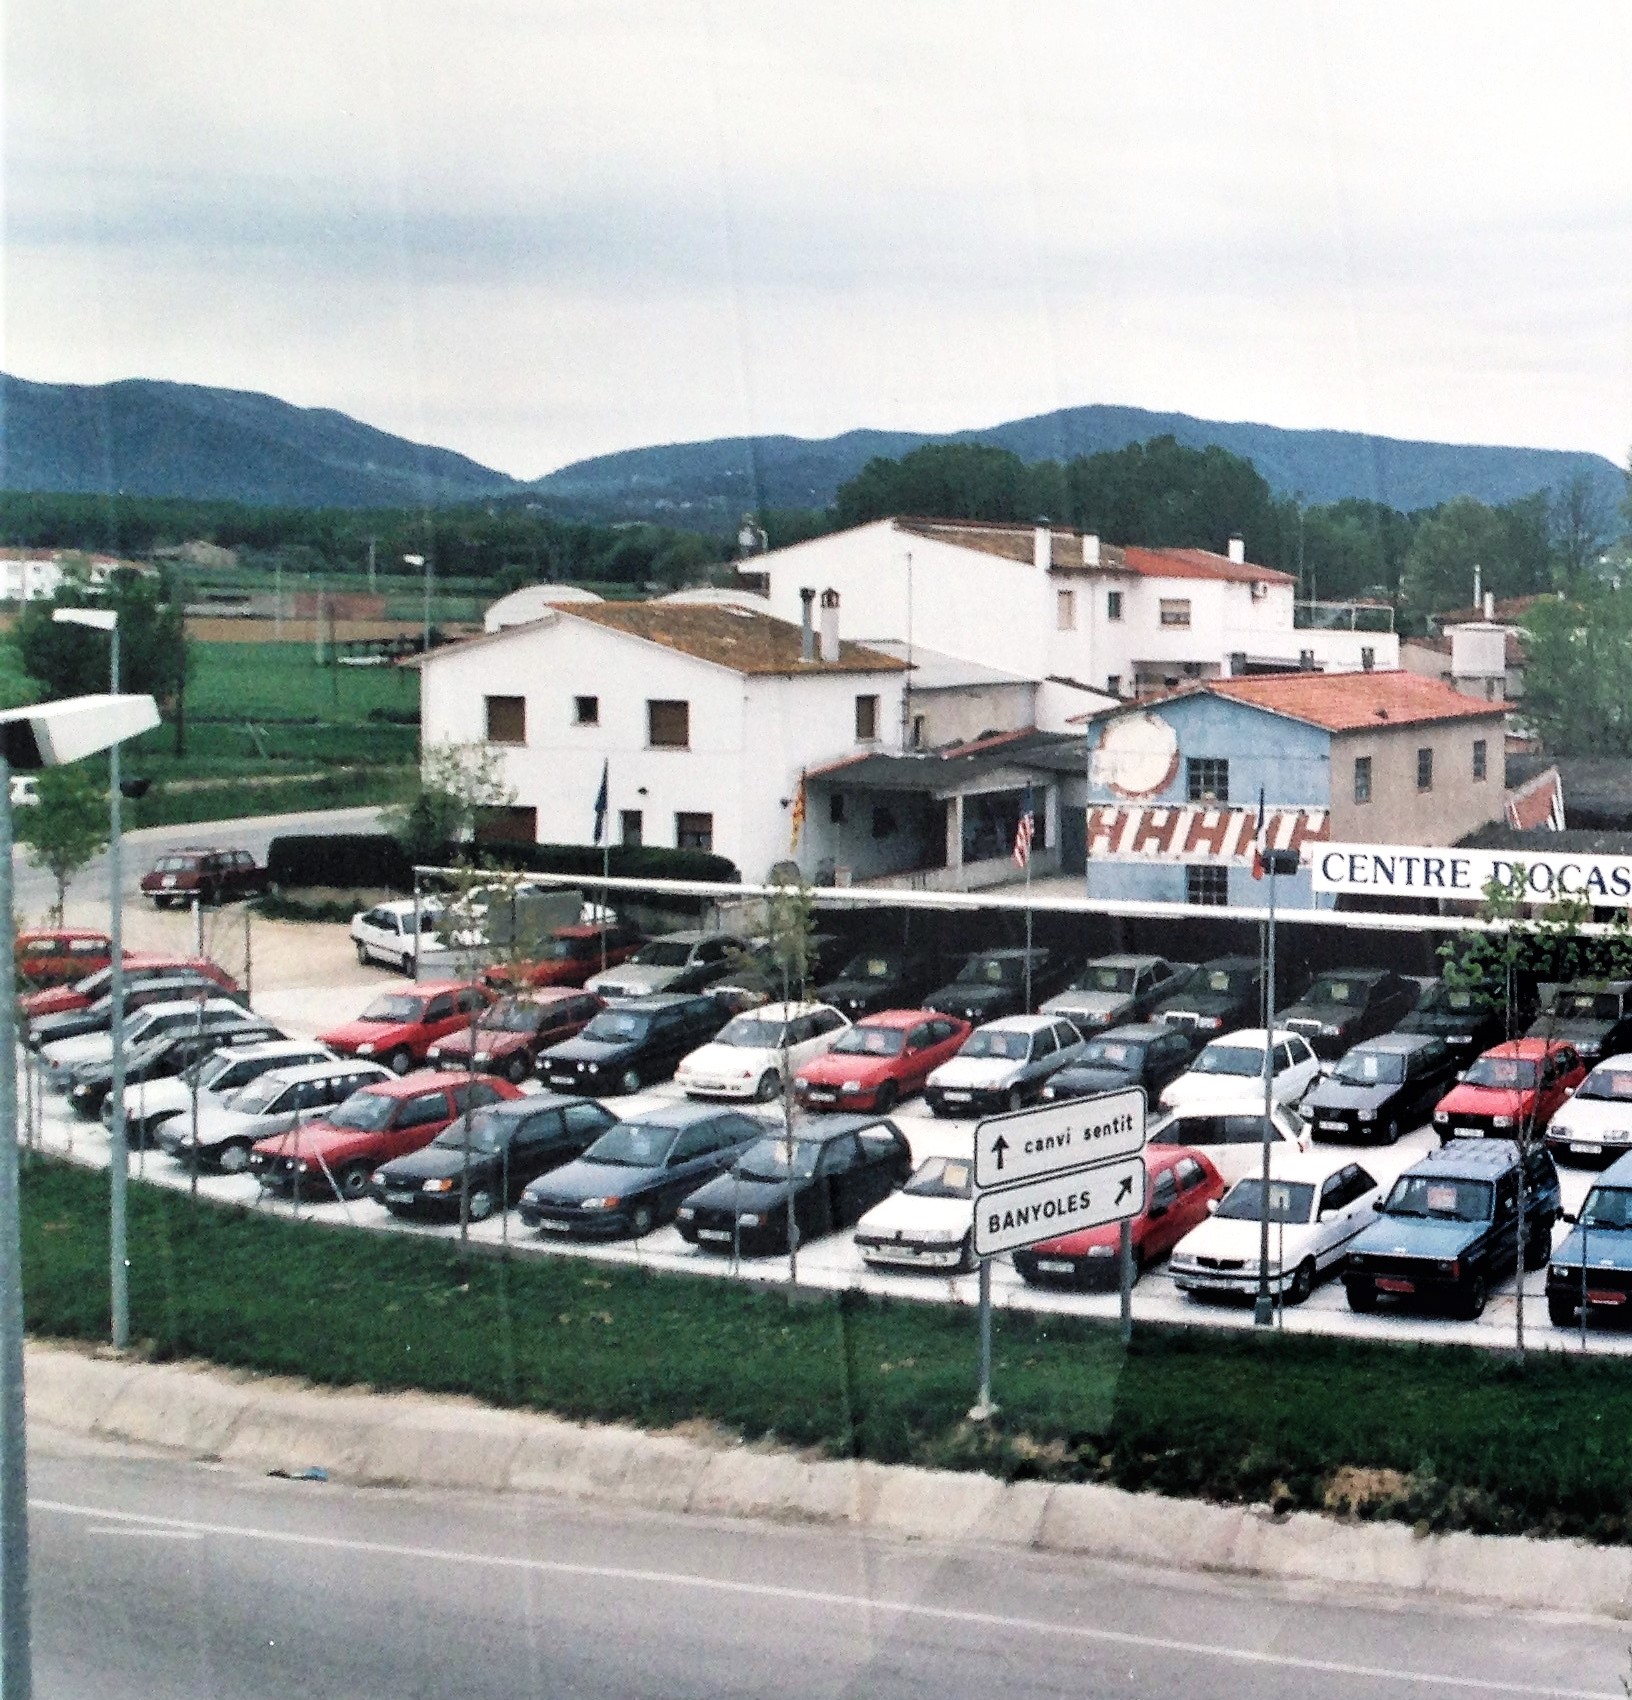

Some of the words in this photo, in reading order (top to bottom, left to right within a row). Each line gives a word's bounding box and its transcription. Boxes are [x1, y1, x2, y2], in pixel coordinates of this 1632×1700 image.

[1321, 852, 1470, 889] CENTRE
[1024, 1126, 1071, 1154] canvi
[1083, 1114, 1133, 1142] sentit
[988, 1190, 1091, 1234] BANYOLES
